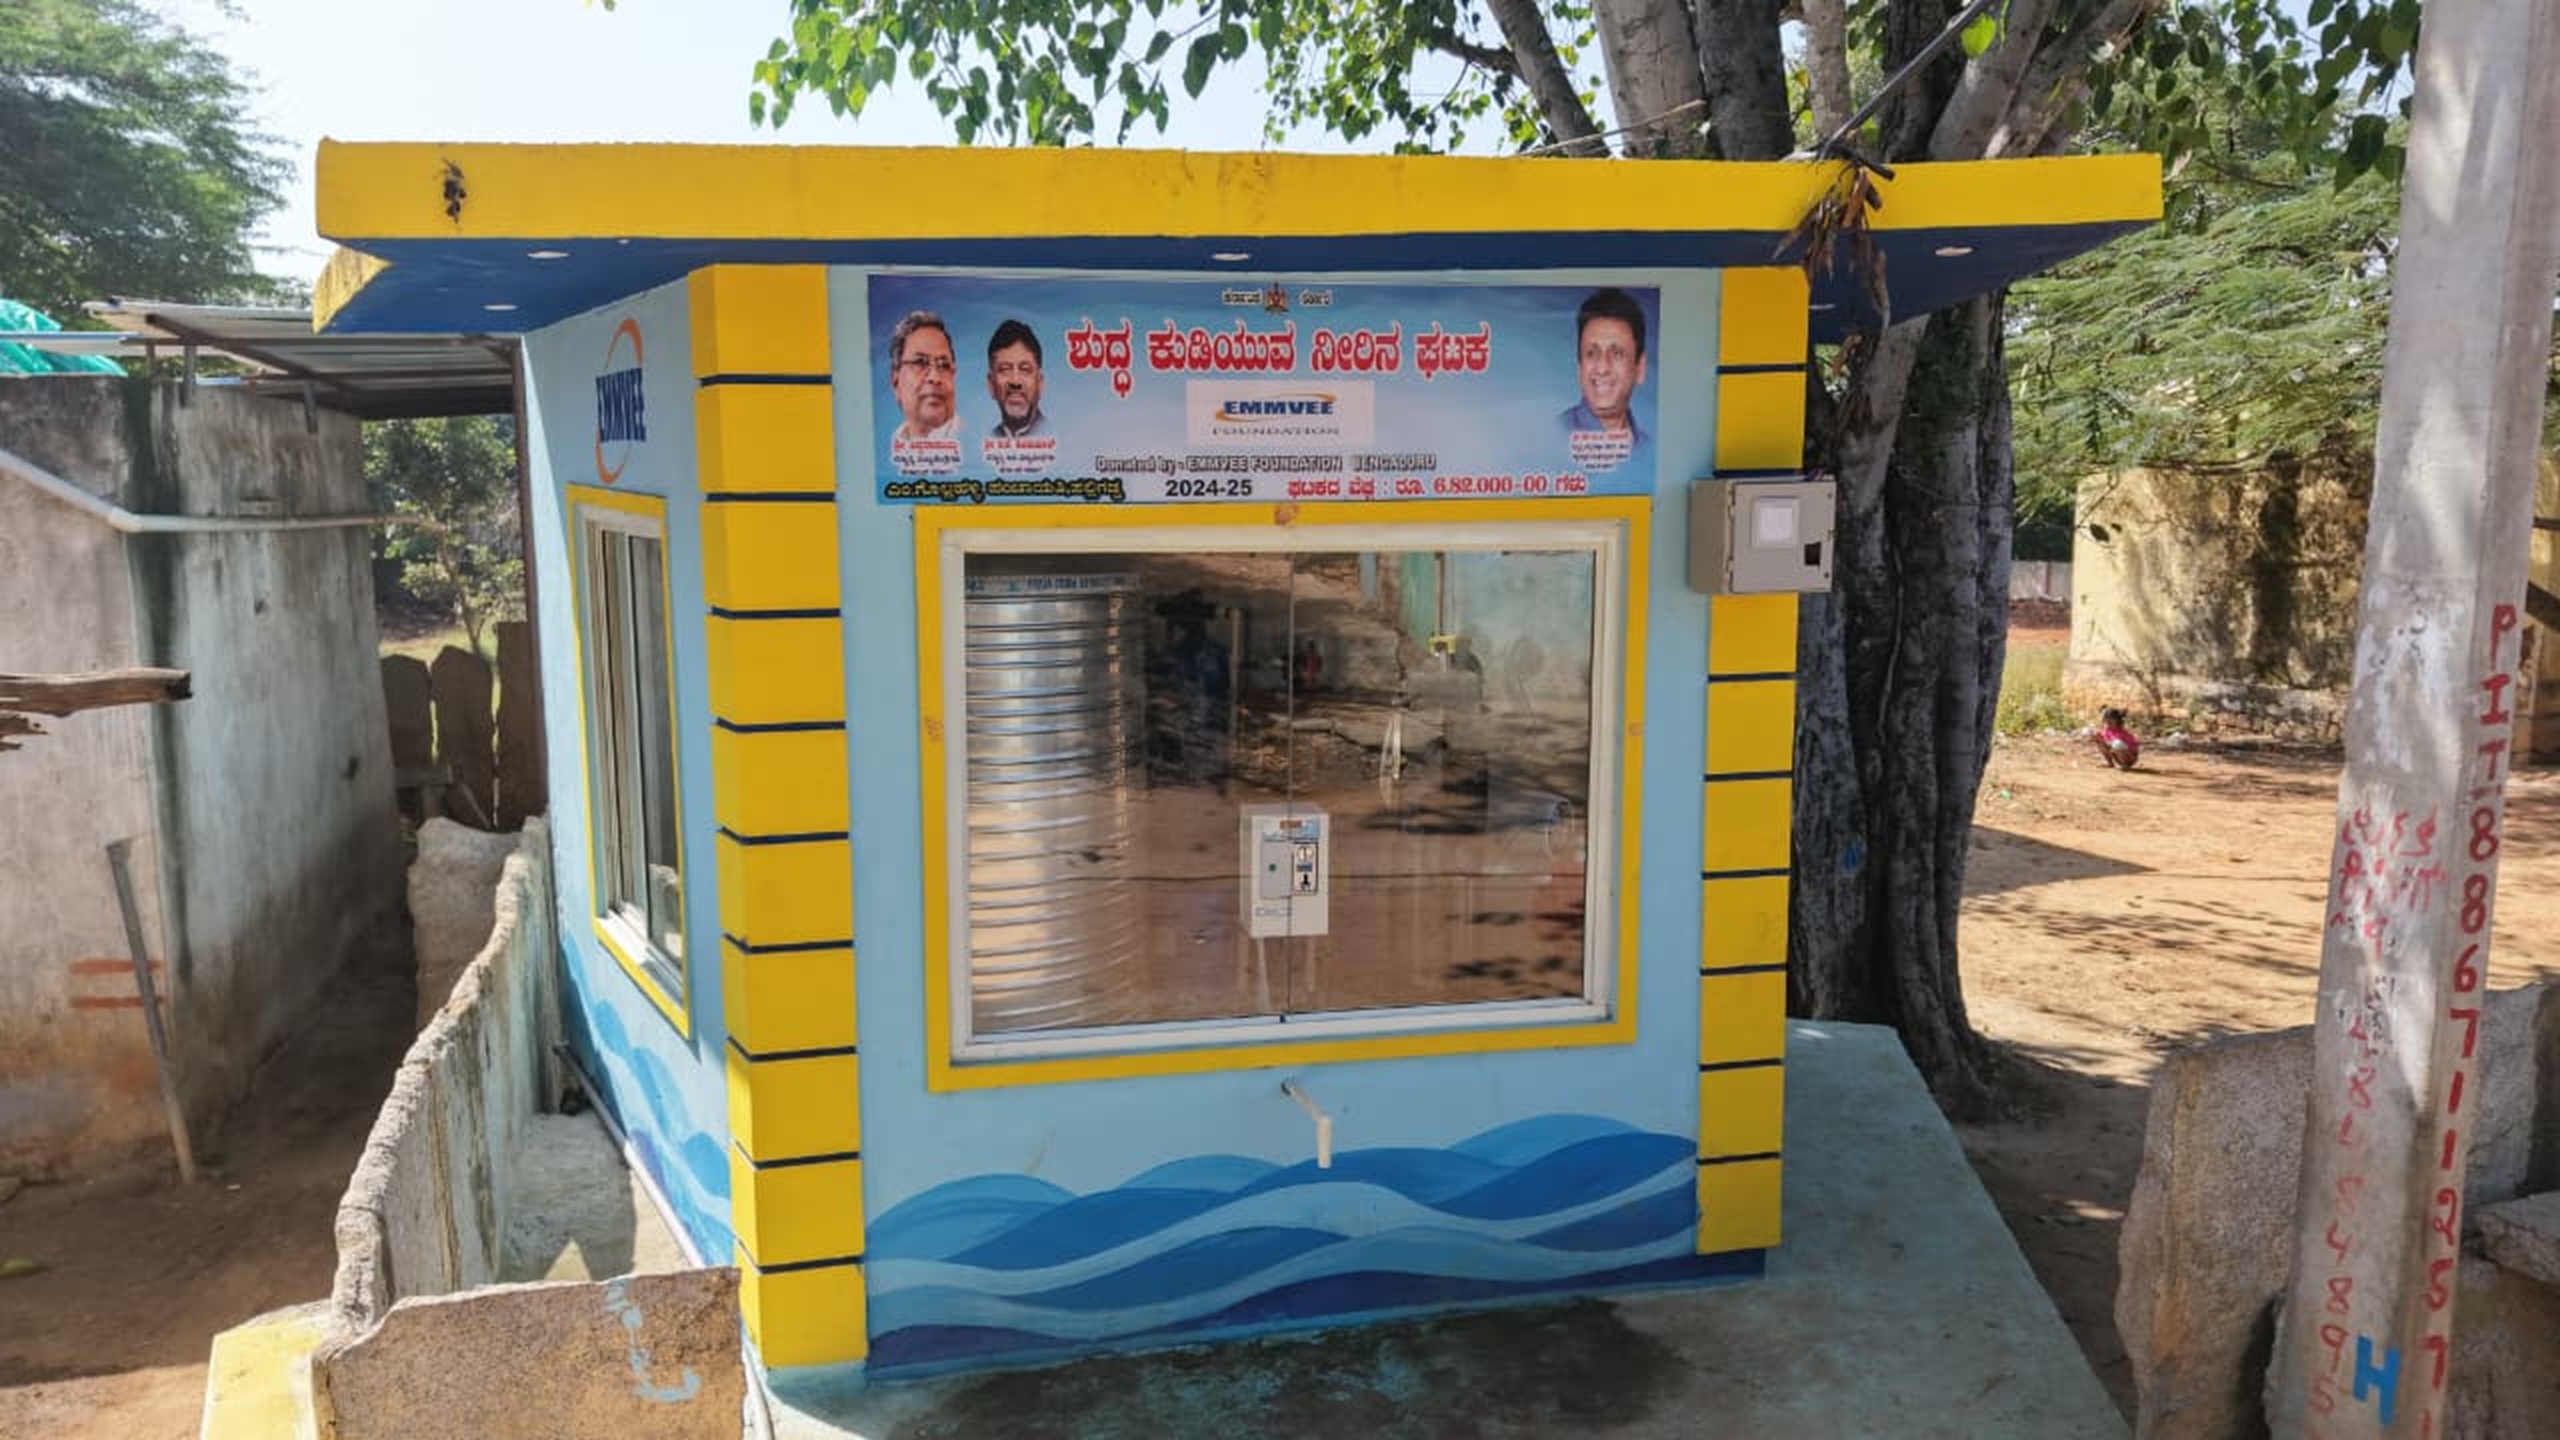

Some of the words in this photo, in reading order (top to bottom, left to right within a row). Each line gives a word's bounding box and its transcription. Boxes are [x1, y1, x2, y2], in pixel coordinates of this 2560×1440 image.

[1065, 318, 1133, 399] ಶುದ್ಧ
[1147, 318, 1295, 371] ಕುಡಿಯುವ
[1310, 320, 1401, 373] ನೀರಿನ
[1414, 321, 1491, 380] ಘಟಕ
[595, 366, 647, 443] EMMVEE
[1223, 400, 1334, 415] EMMVEE
[1158, 455, 1176, 475] by
[1186, 455, 1249, 472] EMMVEE
[1251, 455, 1342, 472] FOUNDATION
[1164, 479, 1253, 497] 2024-25
[1288, 479, 1341, 500] ಘಟಕದ
